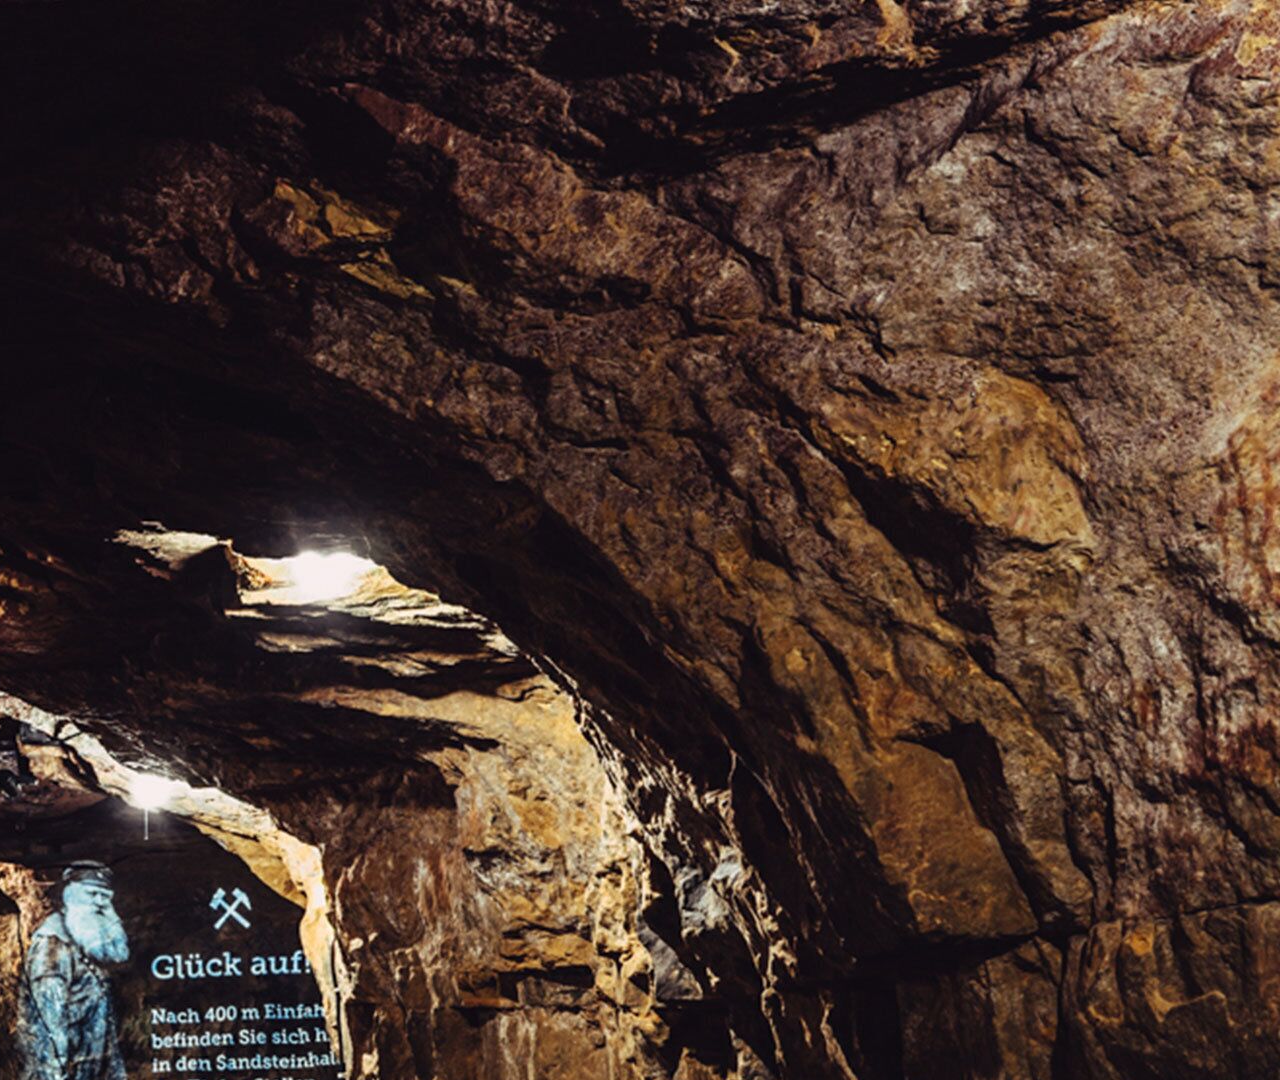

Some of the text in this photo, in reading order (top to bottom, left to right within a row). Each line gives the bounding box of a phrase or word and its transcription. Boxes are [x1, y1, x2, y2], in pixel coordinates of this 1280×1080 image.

[151, 952, 242, 980] Glück
[151, 1004, 326, 1024] Nach 400 m Einfah
[151, 1027, 331, 1049] befinden Sie sich h
[151, 1051, 339, 1073] in den Sandsteinhal
